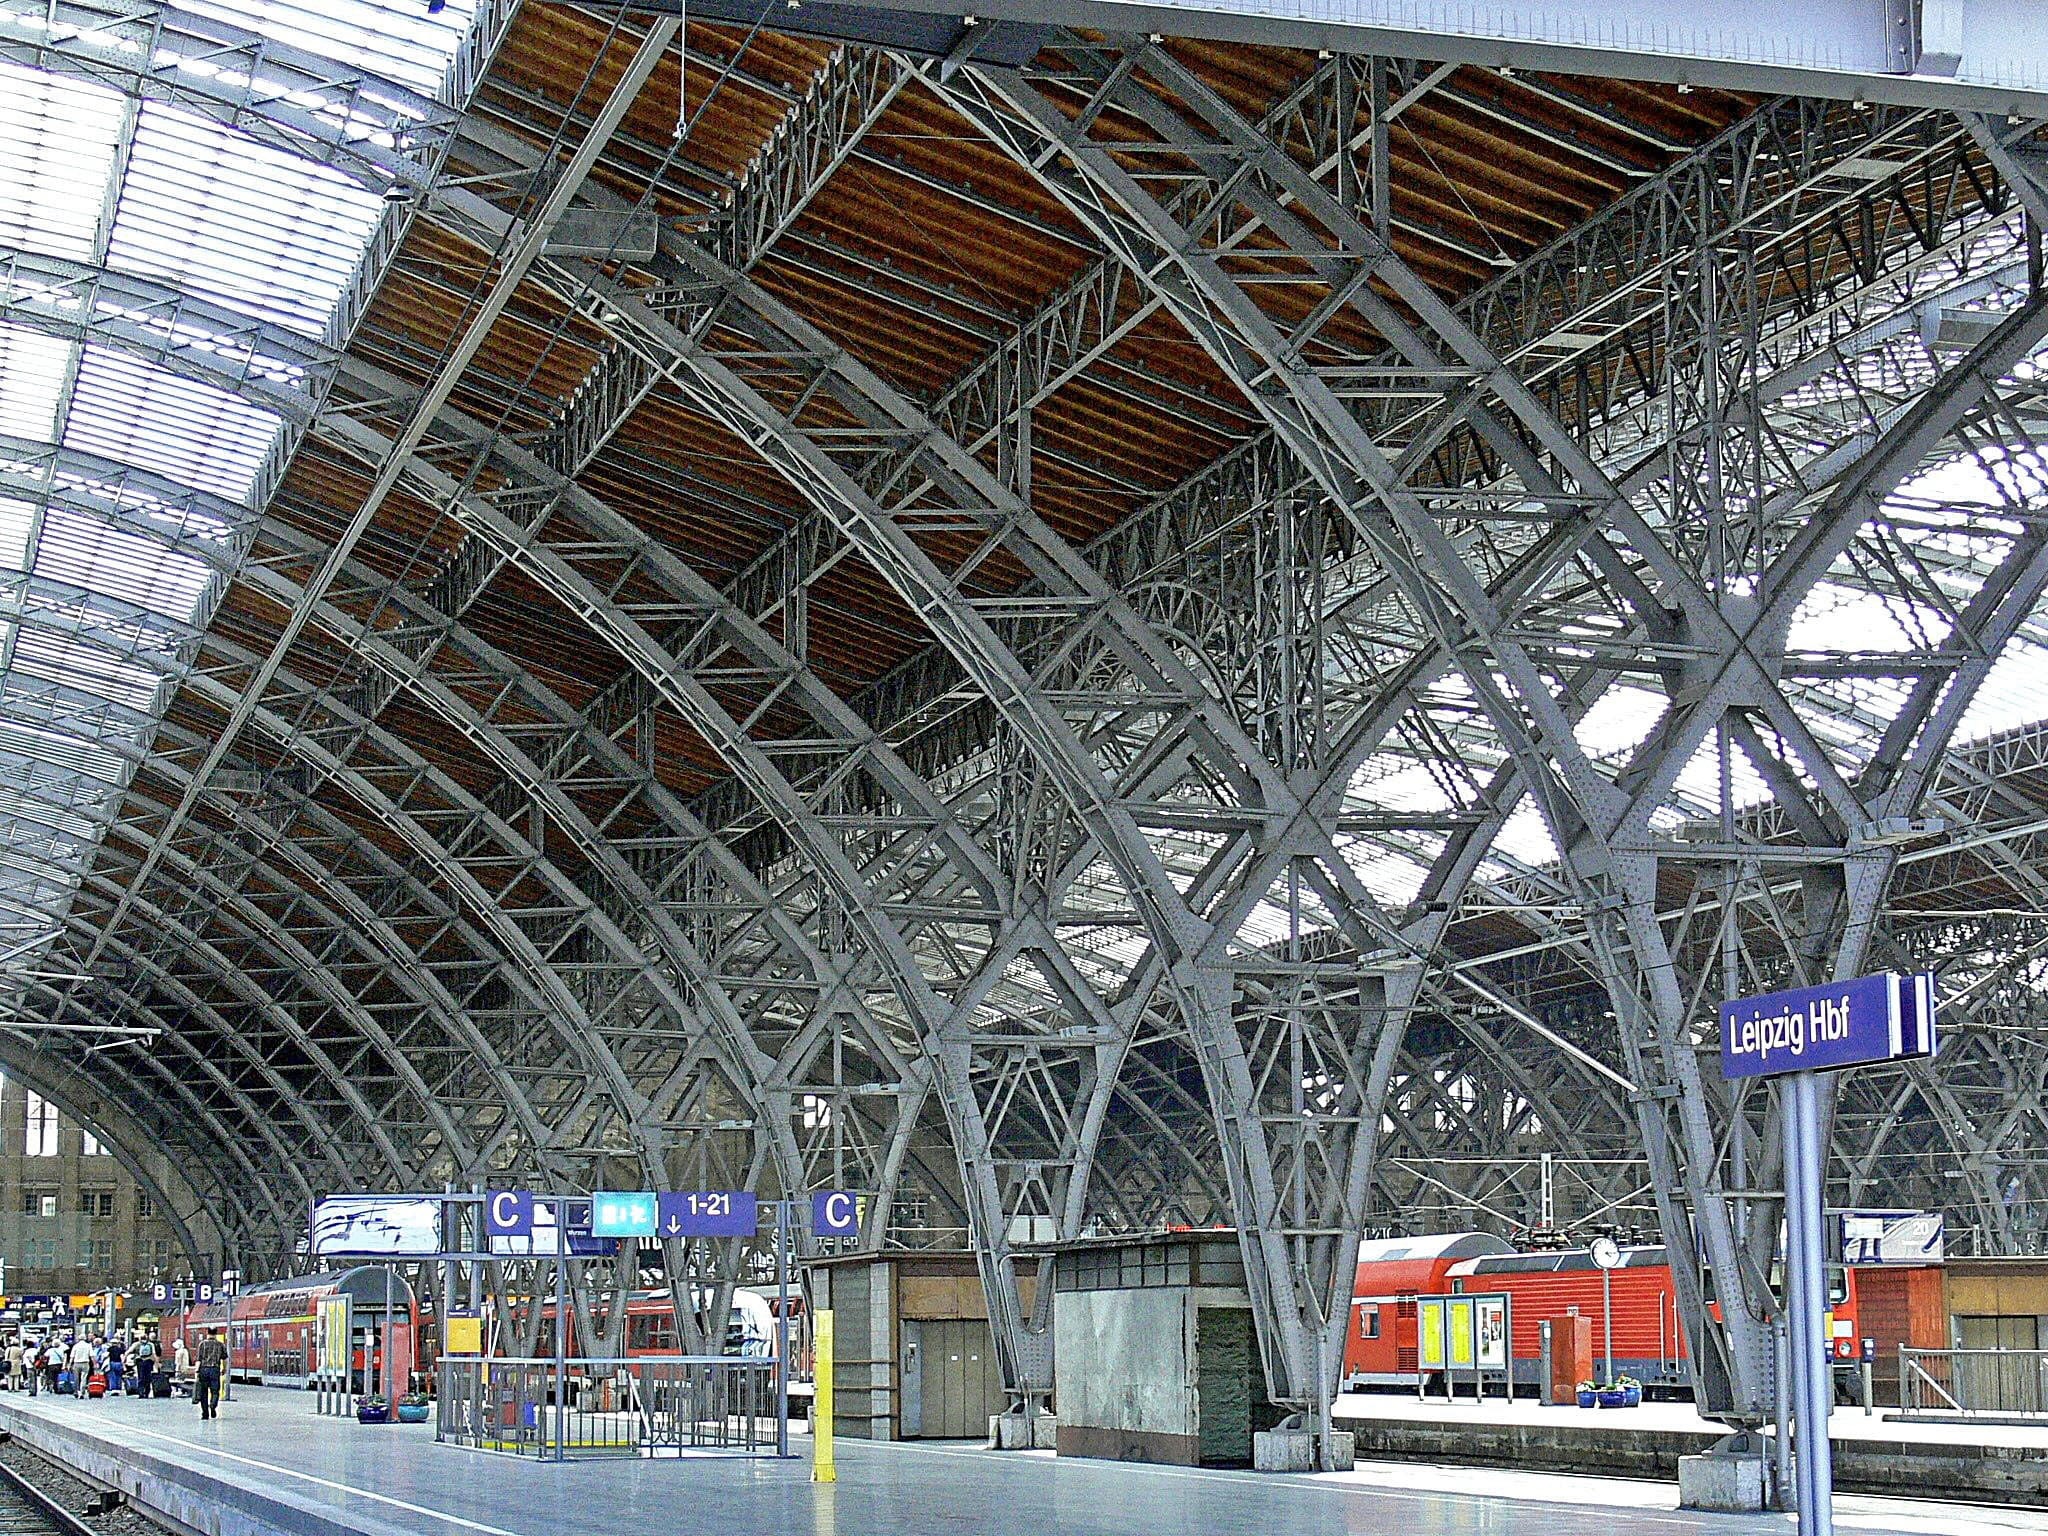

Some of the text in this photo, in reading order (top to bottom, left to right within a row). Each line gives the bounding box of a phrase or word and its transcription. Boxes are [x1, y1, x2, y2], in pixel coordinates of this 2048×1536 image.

[1730, 995, 1849, 1060] Leipzig Hbf
[492, 1191, 519, 1227] C
[687, 1193, 730, 1216] 1-21
[825, 1193, 851, 1228] C
[1912, 1221, 1929, 1236] 20
[154, 1284, 167, 1300] B
[200, 1284, 212, 1300] B
